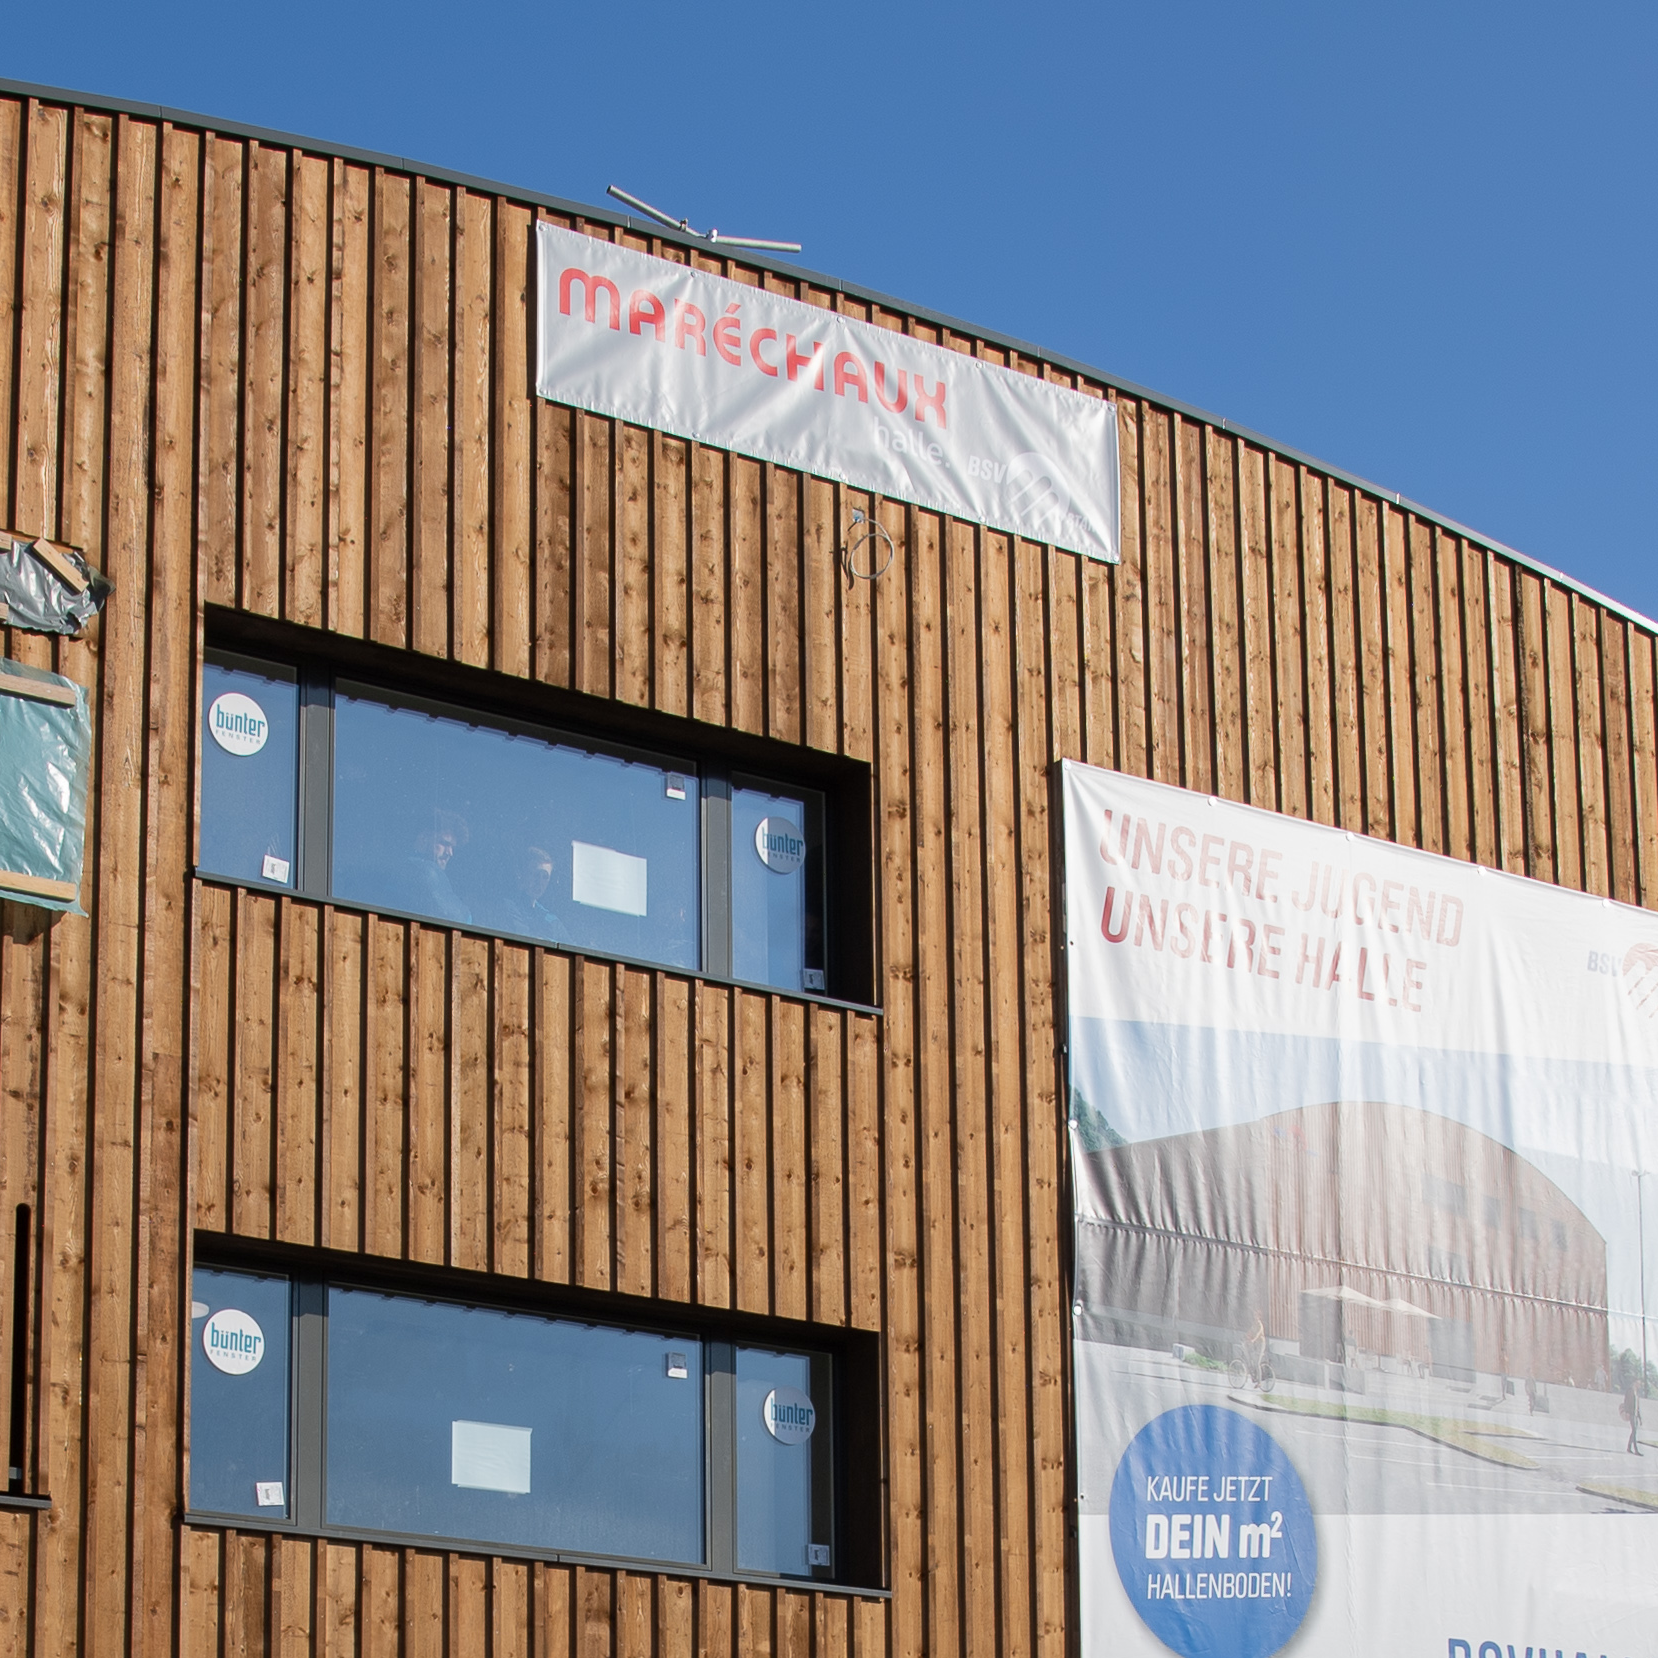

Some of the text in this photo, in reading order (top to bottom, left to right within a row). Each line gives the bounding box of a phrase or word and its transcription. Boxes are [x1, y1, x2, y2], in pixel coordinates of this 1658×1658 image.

[559, 267, 947, 430] MARÉCHAUX
[873, 416, 951, 469] halle.
[968, 455, 1008, 485] BSV
[216, 703, 265, 738] bünter
[215, 728, 261, 745] FENSTER
[762, 826, 804, 857] bünter
[1099, 809, 1465, 948] UNSERE JUGEND
[1100, 885, 1428, 1013] UNSERE HALLE
[1587, 950, 1622, 977] BSV
[211, 1321, 262, 1355] bünter
[210, 1348, 257, 1362] FENSTER
[771, 1397, 814, 1426] bünter
[1146, 1475, 1273, 1503] KAUFE JETZT
[1145, 1513, 1230, 1560] DEIN
[1147, 1572, 1292, 1600] HALLENBODEN!
